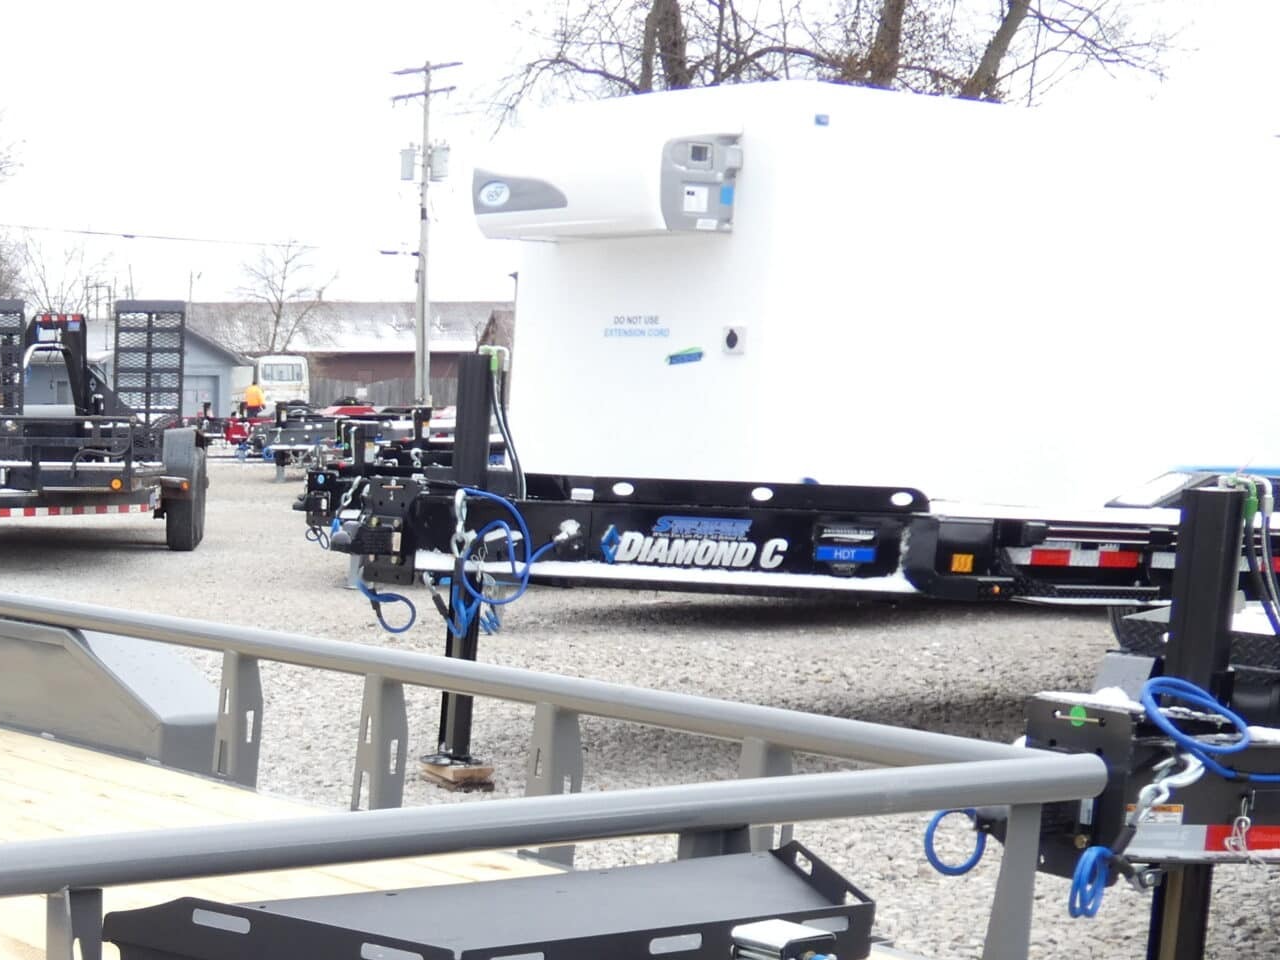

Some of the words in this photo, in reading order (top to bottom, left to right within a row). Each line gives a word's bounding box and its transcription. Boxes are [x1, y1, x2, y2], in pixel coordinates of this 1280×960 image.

[613, 315, 625, 325] DO
[627, 315, 642, 325] NOT
[644, 315, 659, 325] USE
[614, 531, 757, 568] DIAMOND
[759, 538, 789, 569] C
[834, 549, 856, 560] HDT
